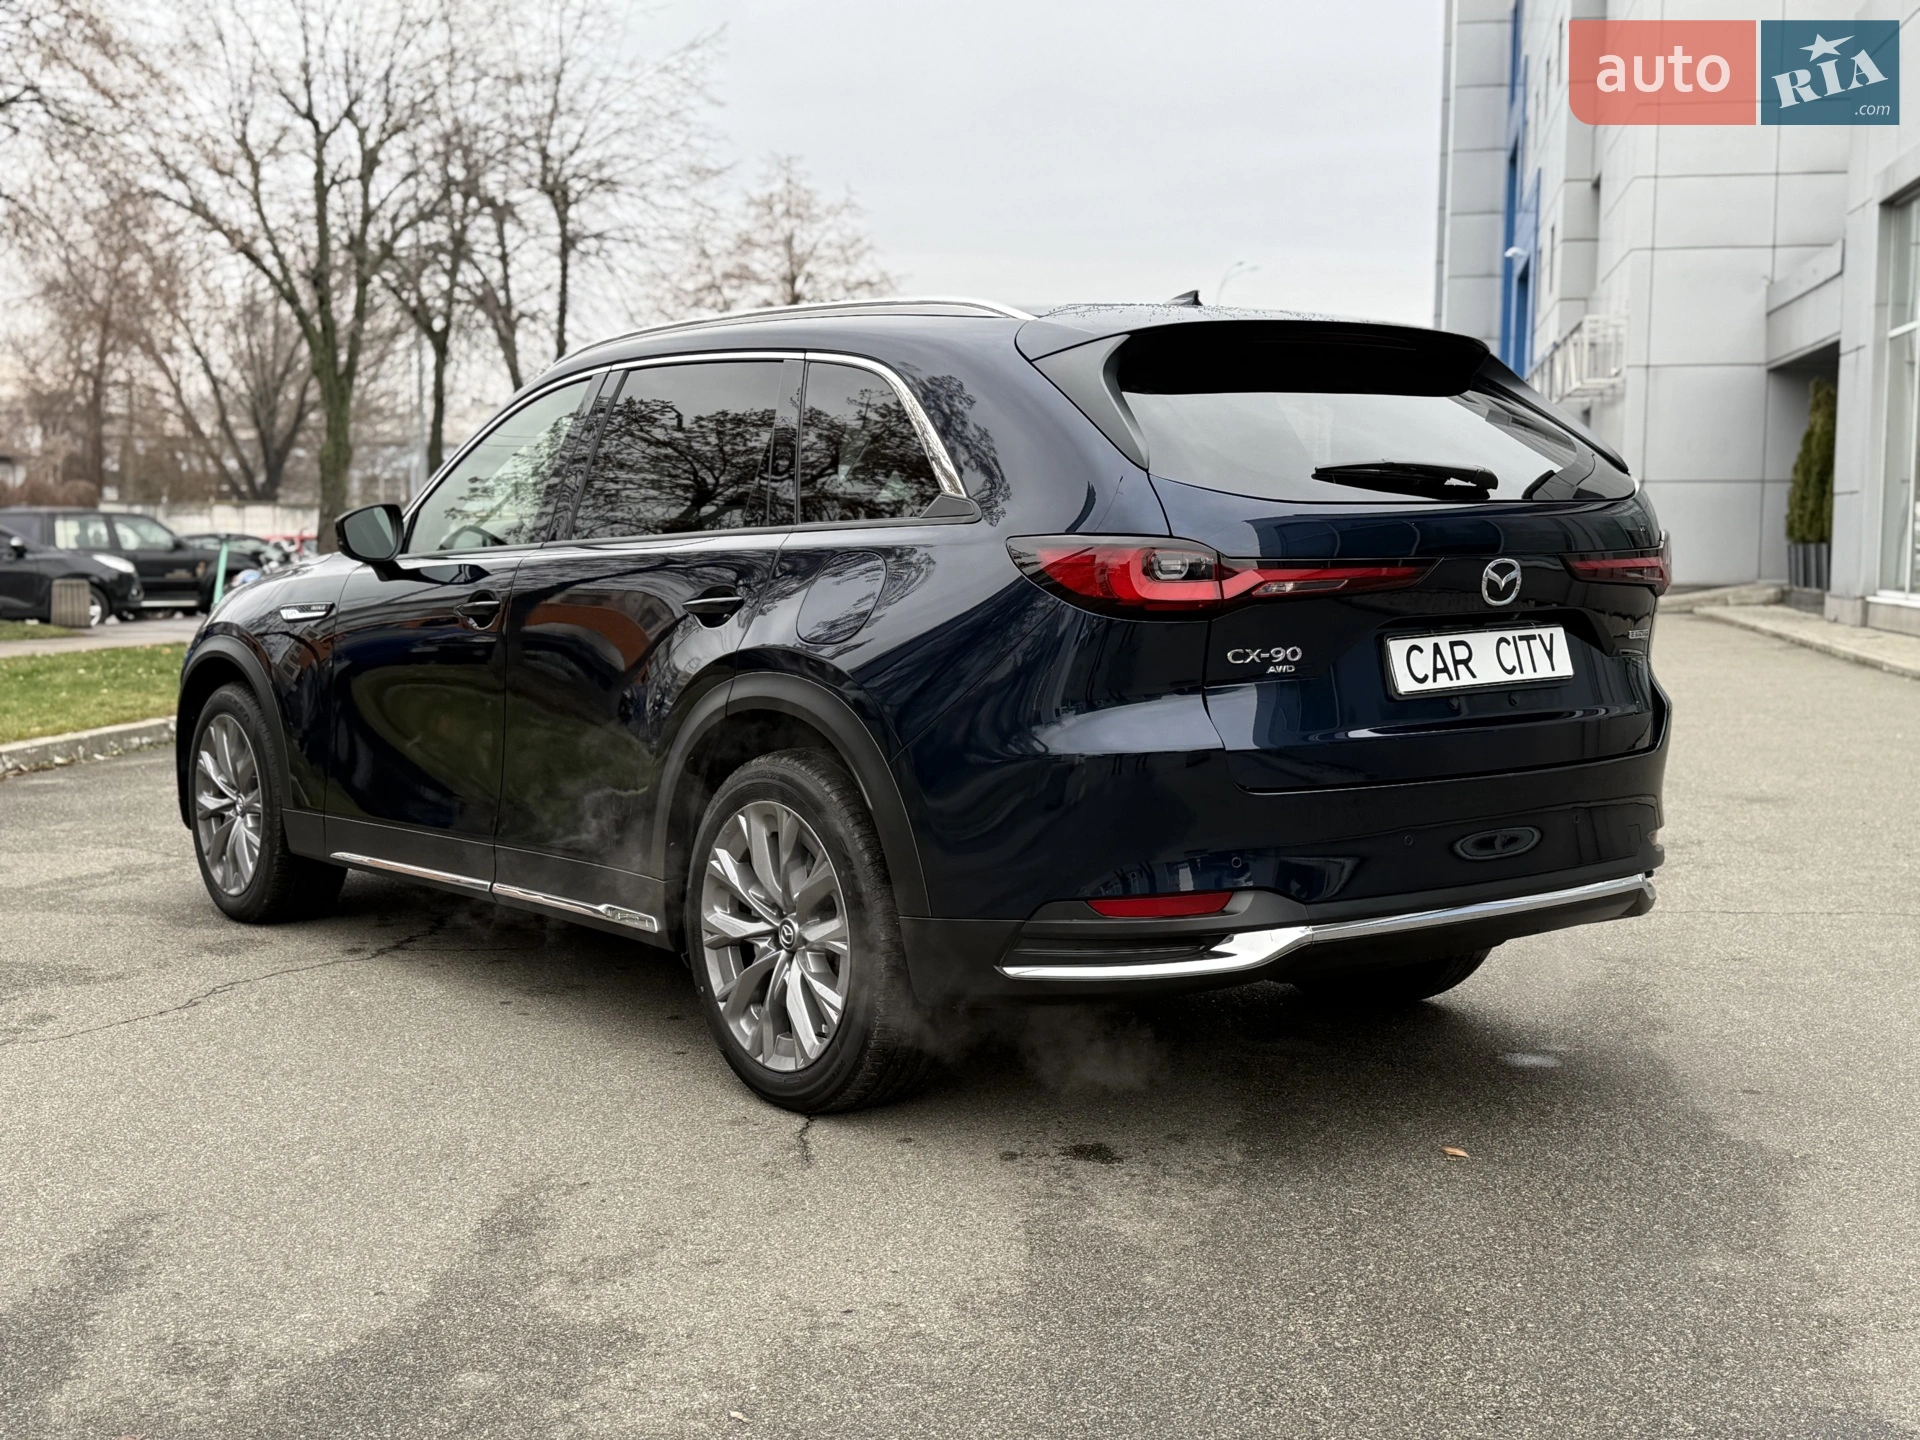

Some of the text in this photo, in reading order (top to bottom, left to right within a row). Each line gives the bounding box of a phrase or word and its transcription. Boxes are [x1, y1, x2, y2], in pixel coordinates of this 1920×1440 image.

[1226, 646, 1303, 664] CX-90
[1405, 632, 1556, 685] CAR CITY
[1265, 665, 1296, 674] AWD
